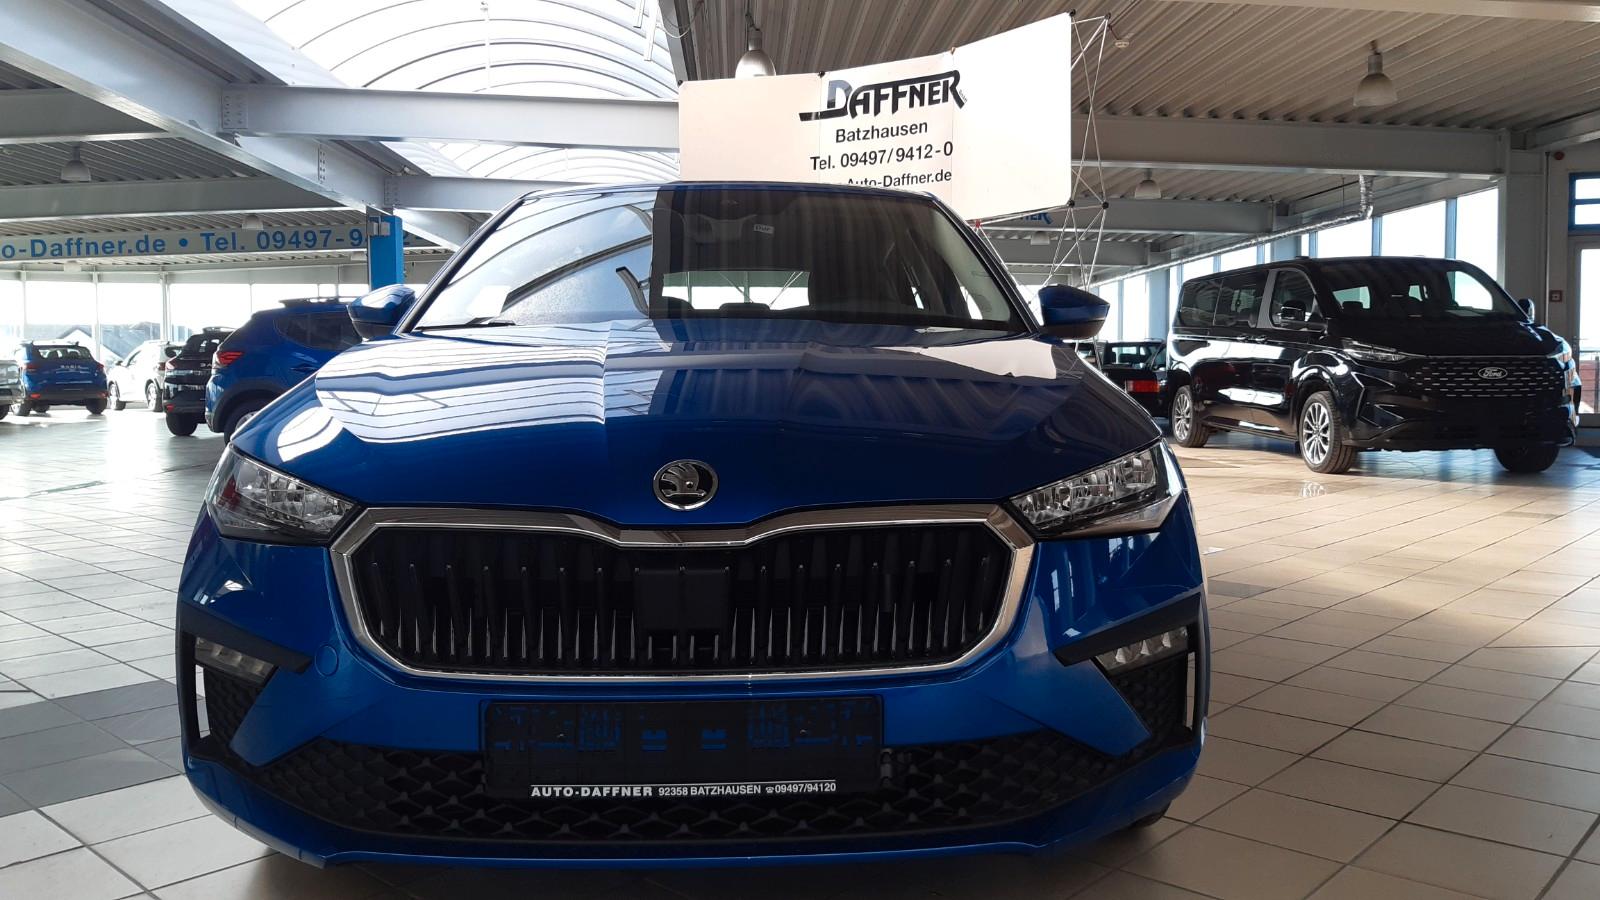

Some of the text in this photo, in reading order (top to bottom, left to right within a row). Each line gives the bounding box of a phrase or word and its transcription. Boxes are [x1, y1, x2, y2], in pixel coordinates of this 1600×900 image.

[799, 70, 966, 121] DAFFNER
[835, 122, 928, 143] Batzhausen
[810, 155, 836, 170] Tel.
[200, 231, 246, 251] Tel.
[531, 786, 653, 797] AUTO-DAFFNER
[658, 786, 689, 796] 92358
[690, 784, 761, 796] BATZHAUSEN
